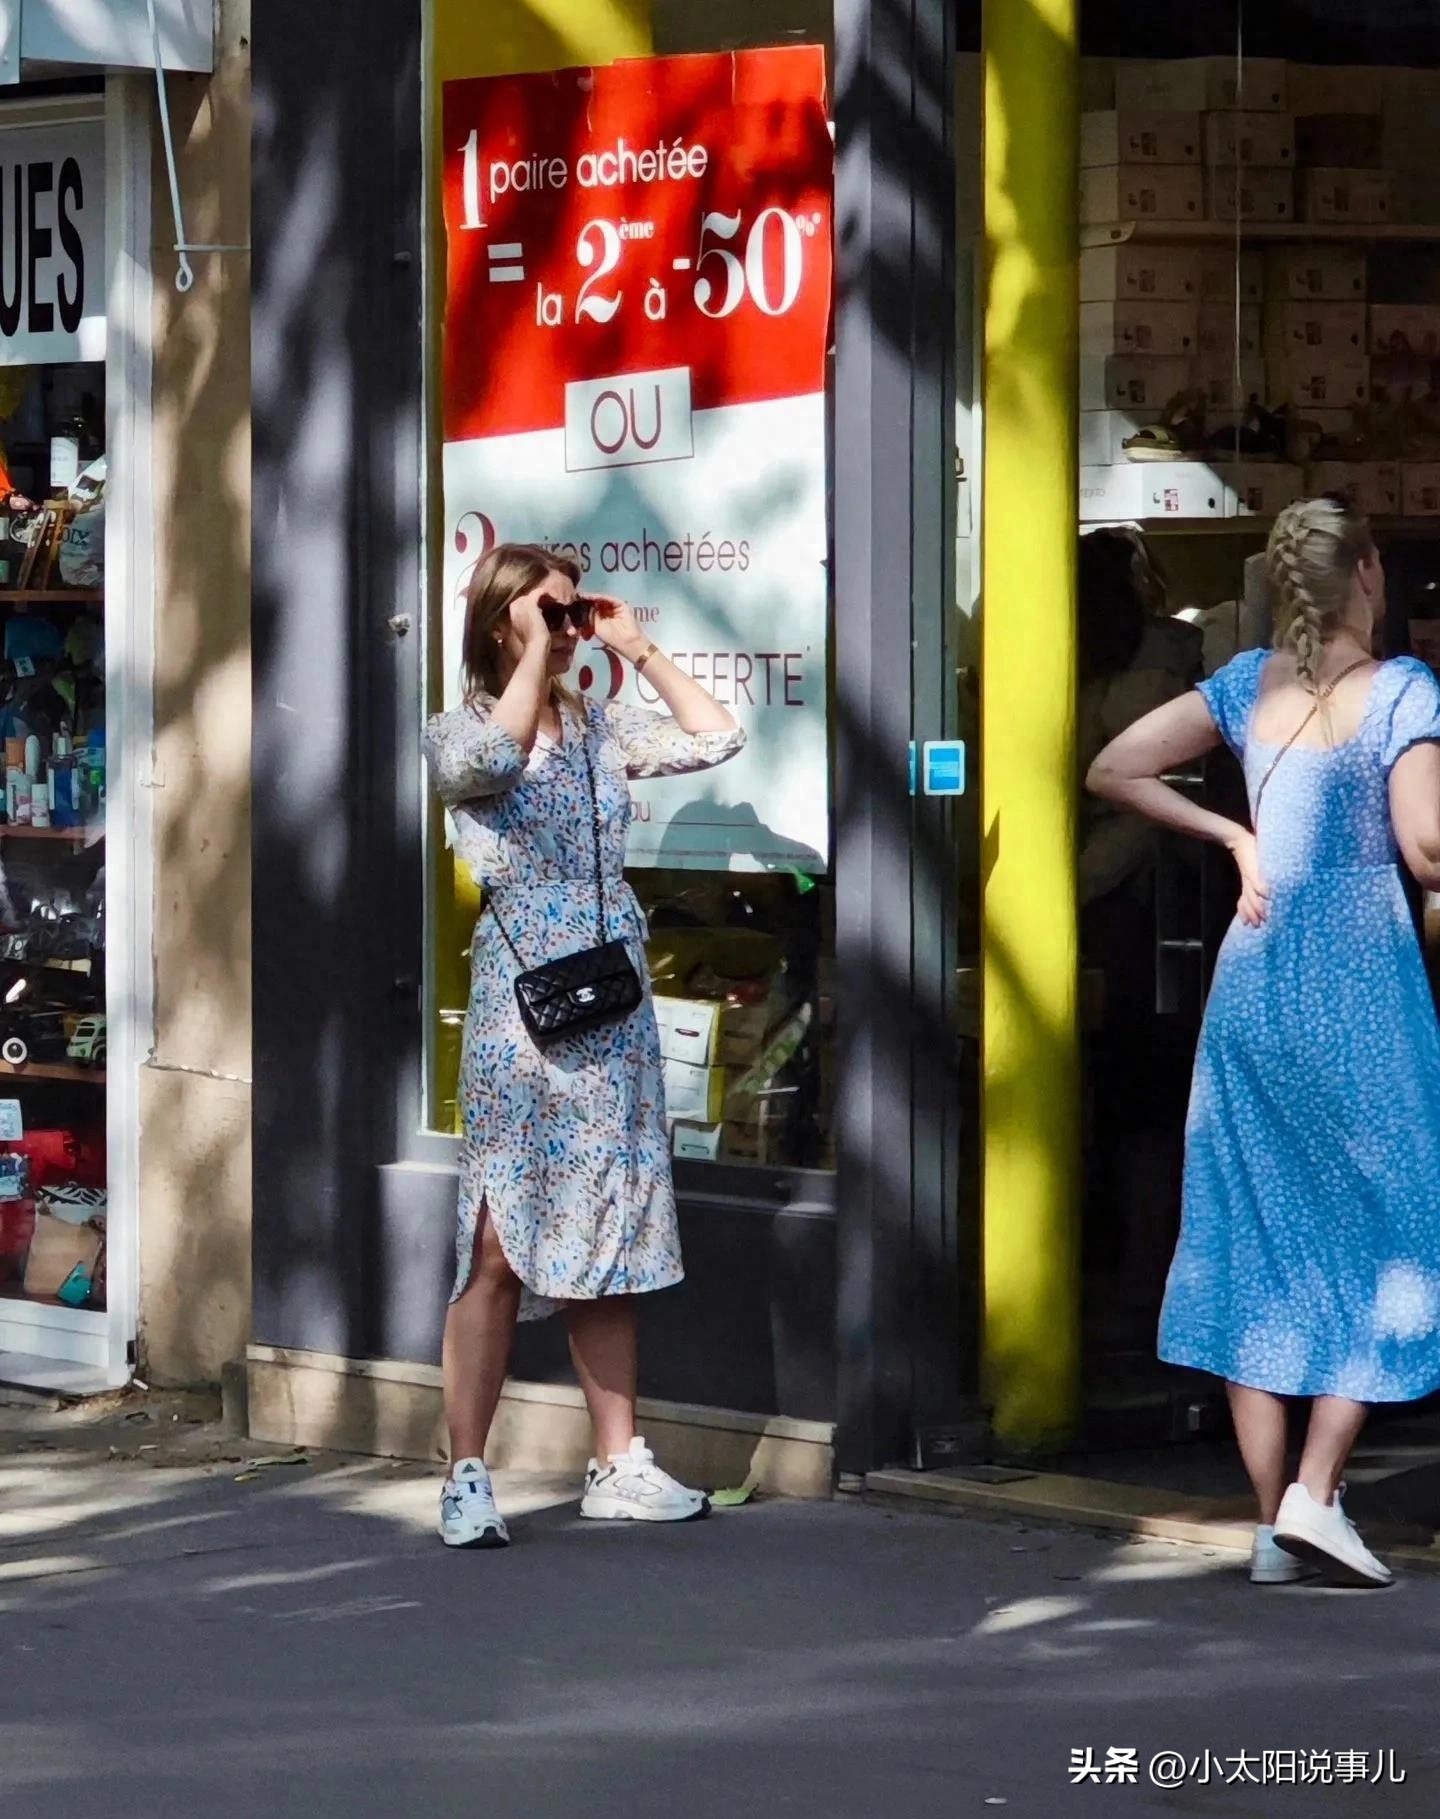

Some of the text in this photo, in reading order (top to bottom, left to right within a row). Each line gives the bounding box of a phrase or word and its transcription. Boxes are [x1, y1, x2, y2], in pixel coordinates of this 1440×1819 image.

[457, 129, 708, 229] 1 paire achetée
[537, 282, 562, 326] la
[644, 278, 667, 320] à
[590, 384, 661, 454] OU
[600, 528, 750, 571] achetées
